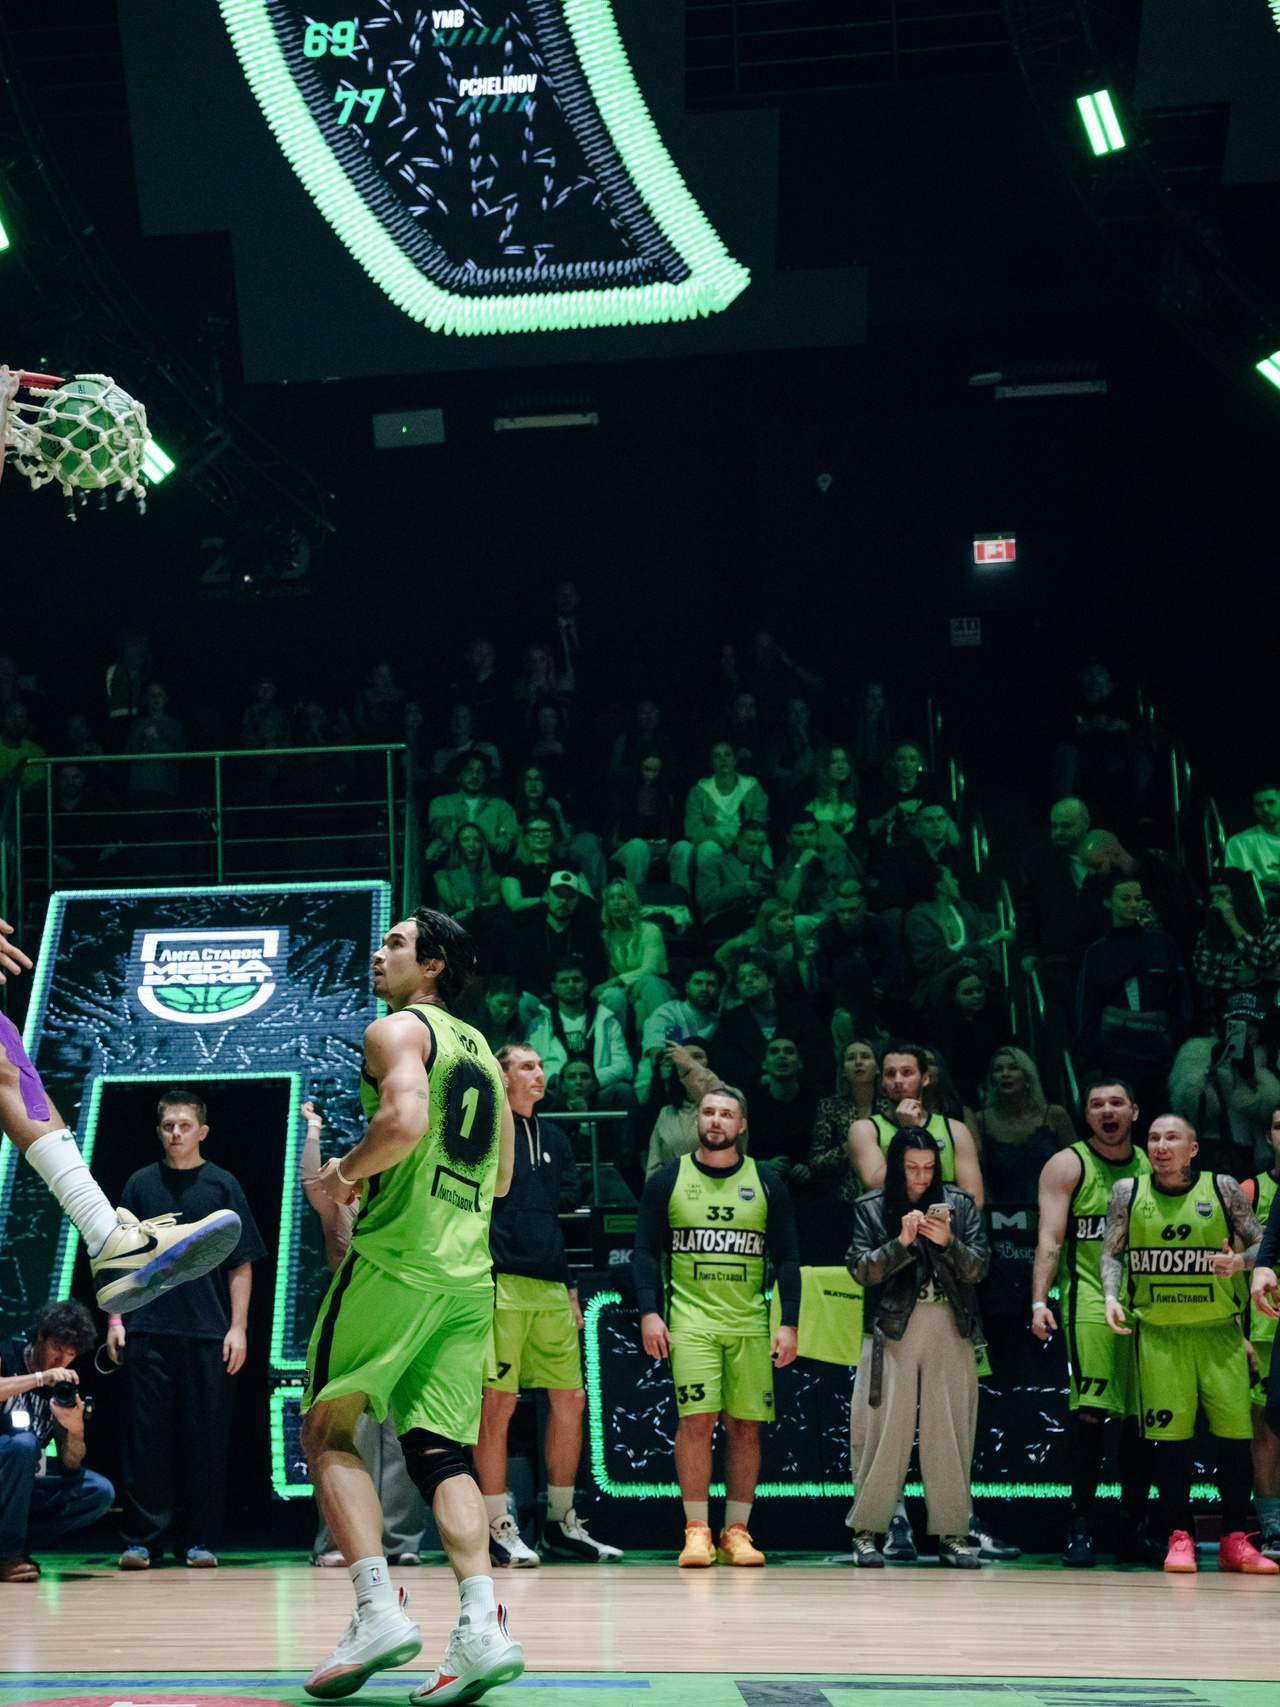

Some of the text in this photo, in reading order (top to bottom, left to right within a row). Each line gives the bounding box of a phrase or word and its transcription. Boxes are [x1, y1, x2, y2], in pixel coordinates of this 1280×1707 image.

[432, 9, 465, 28] YMB
[303, 21, 355, 57] 69
[459, 74, 538, 97] PCHELINOV
[335, 88, 386, 125] 77
[144, 960, 272, 975] MEDIA
[142, 972, 273, 985] BASKET
[460, 1086, 479, 1139] 1
[706, 1206, 735, 1222] 33
[1161, 1224, 1192, 1241] 69
[677, 1383, 706, 1405] 33
[1080, 1376, 1109, 1397] 77
[1145, 1408, 1173, 1429] 69
